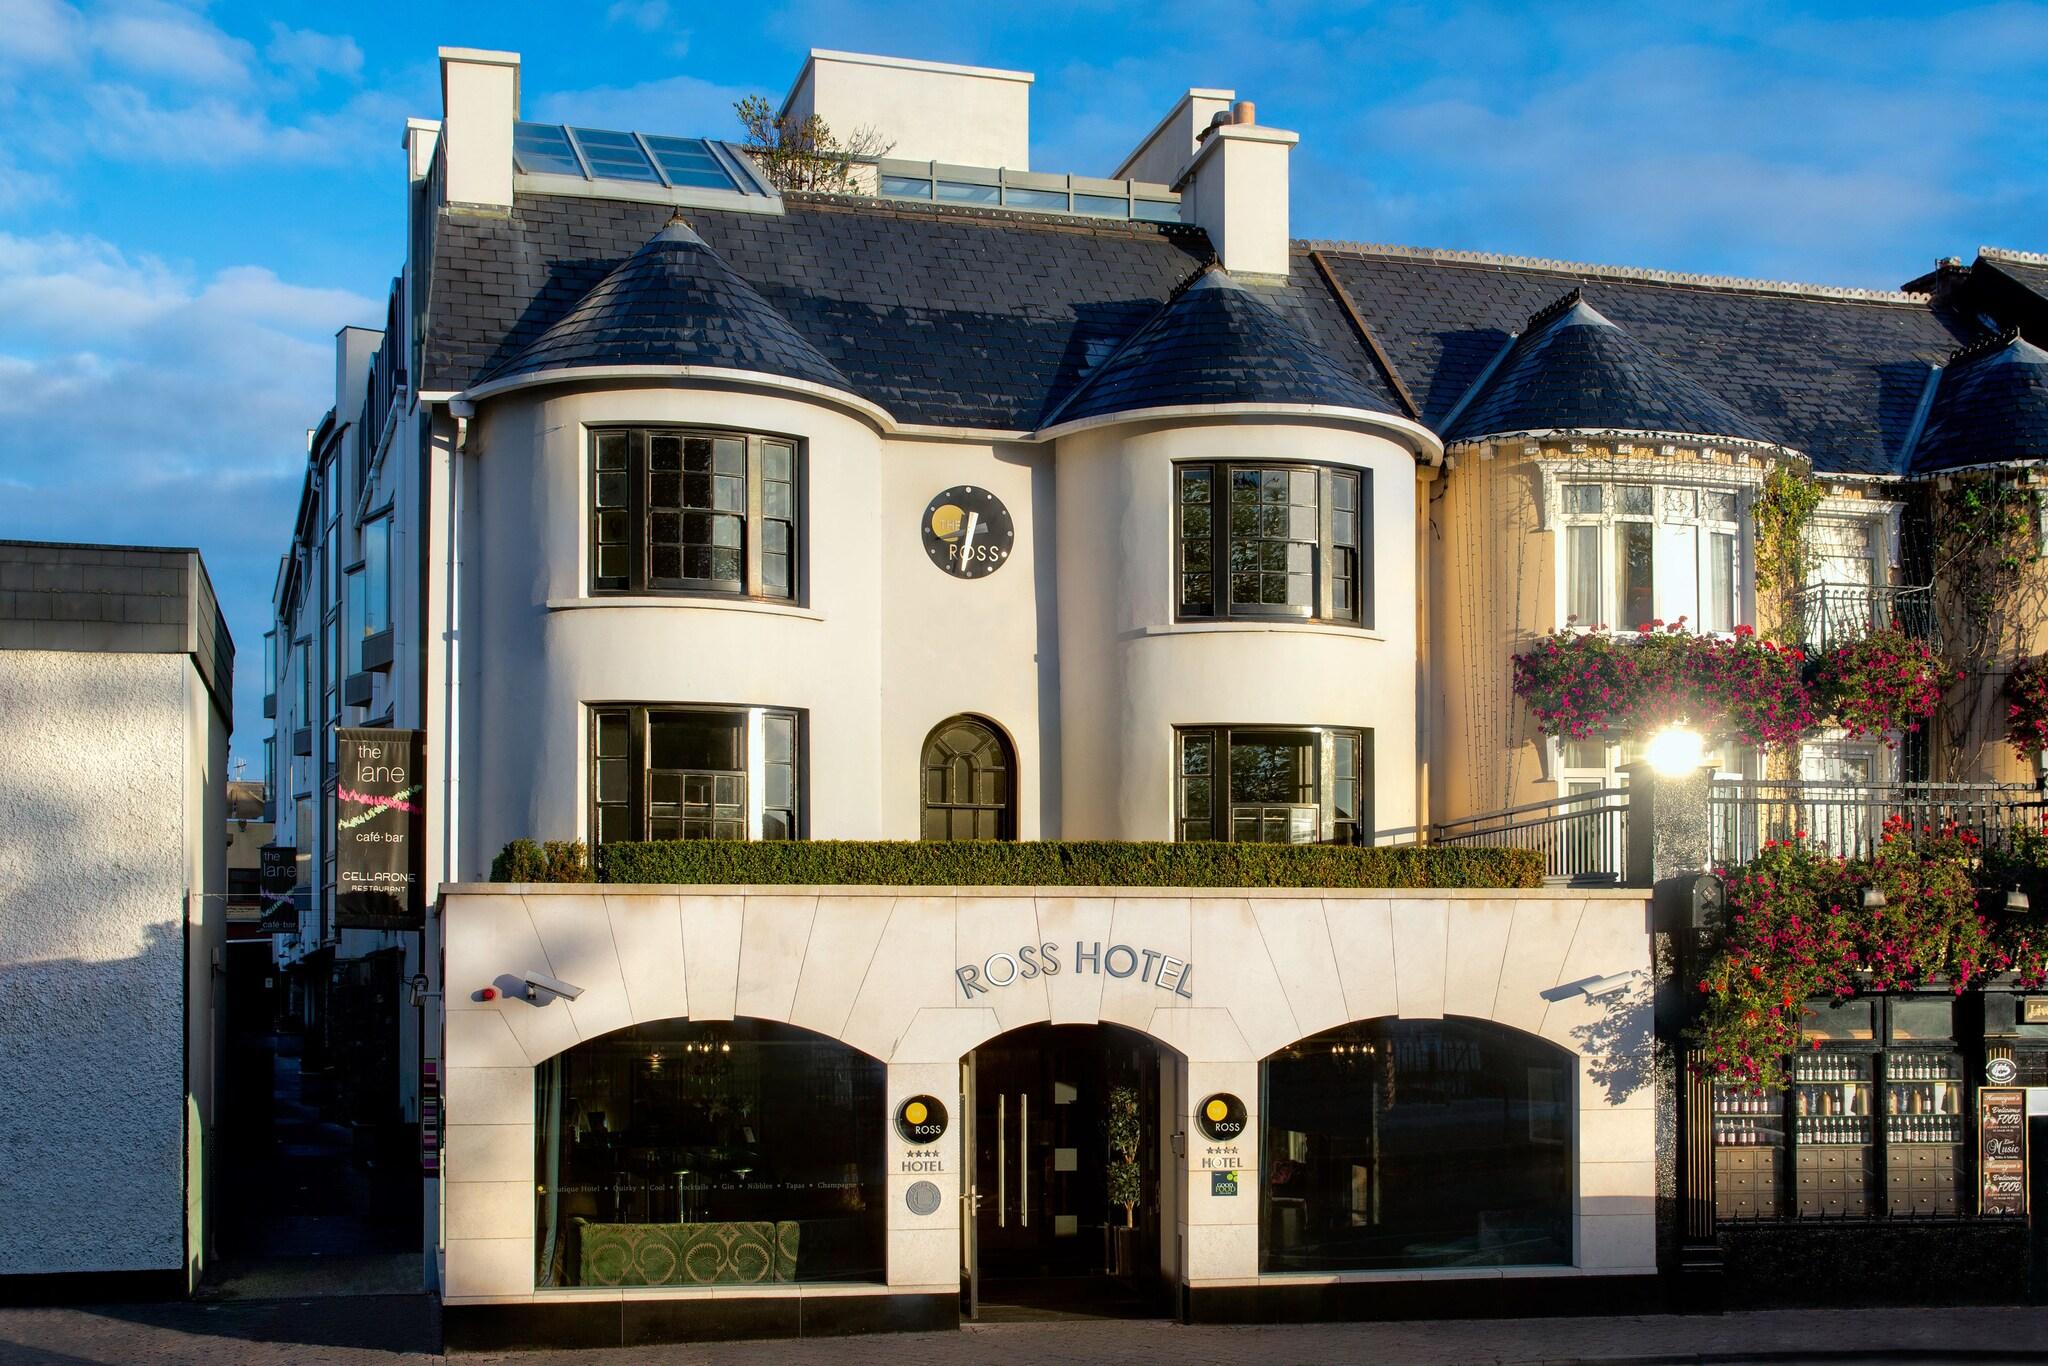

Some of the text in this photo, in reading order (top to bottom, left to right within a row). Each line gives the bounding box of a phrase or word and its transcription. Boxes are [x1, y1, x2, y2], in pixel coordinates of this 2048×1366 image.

[949, 543, 1000, 561] ROSS
[359, 744, 382, 759] the
[357, 760, 405, 783] lane
[263, 851, 281, 862] the
[263, 863, 297, 878] lane
[342, 871, 416, 883] CELLARONE
[351, 884, 406, 893] RESTAURANT
[956, 941, 1192, 999] ROSS HOTEL
[1997, 1114, 2021, 1125] FOOD
[915, 1125, 941, 1135] ROSS
[1215, 1122, 1241, 1132] ROSS
[1986, 1138, 2020, 1155] Music
[901, 1161, 945, 1172] HOTEL
[1202, 1157, 1243, 1168] HOTEL
[1998, 1181, 2022, 1192] FOOD
